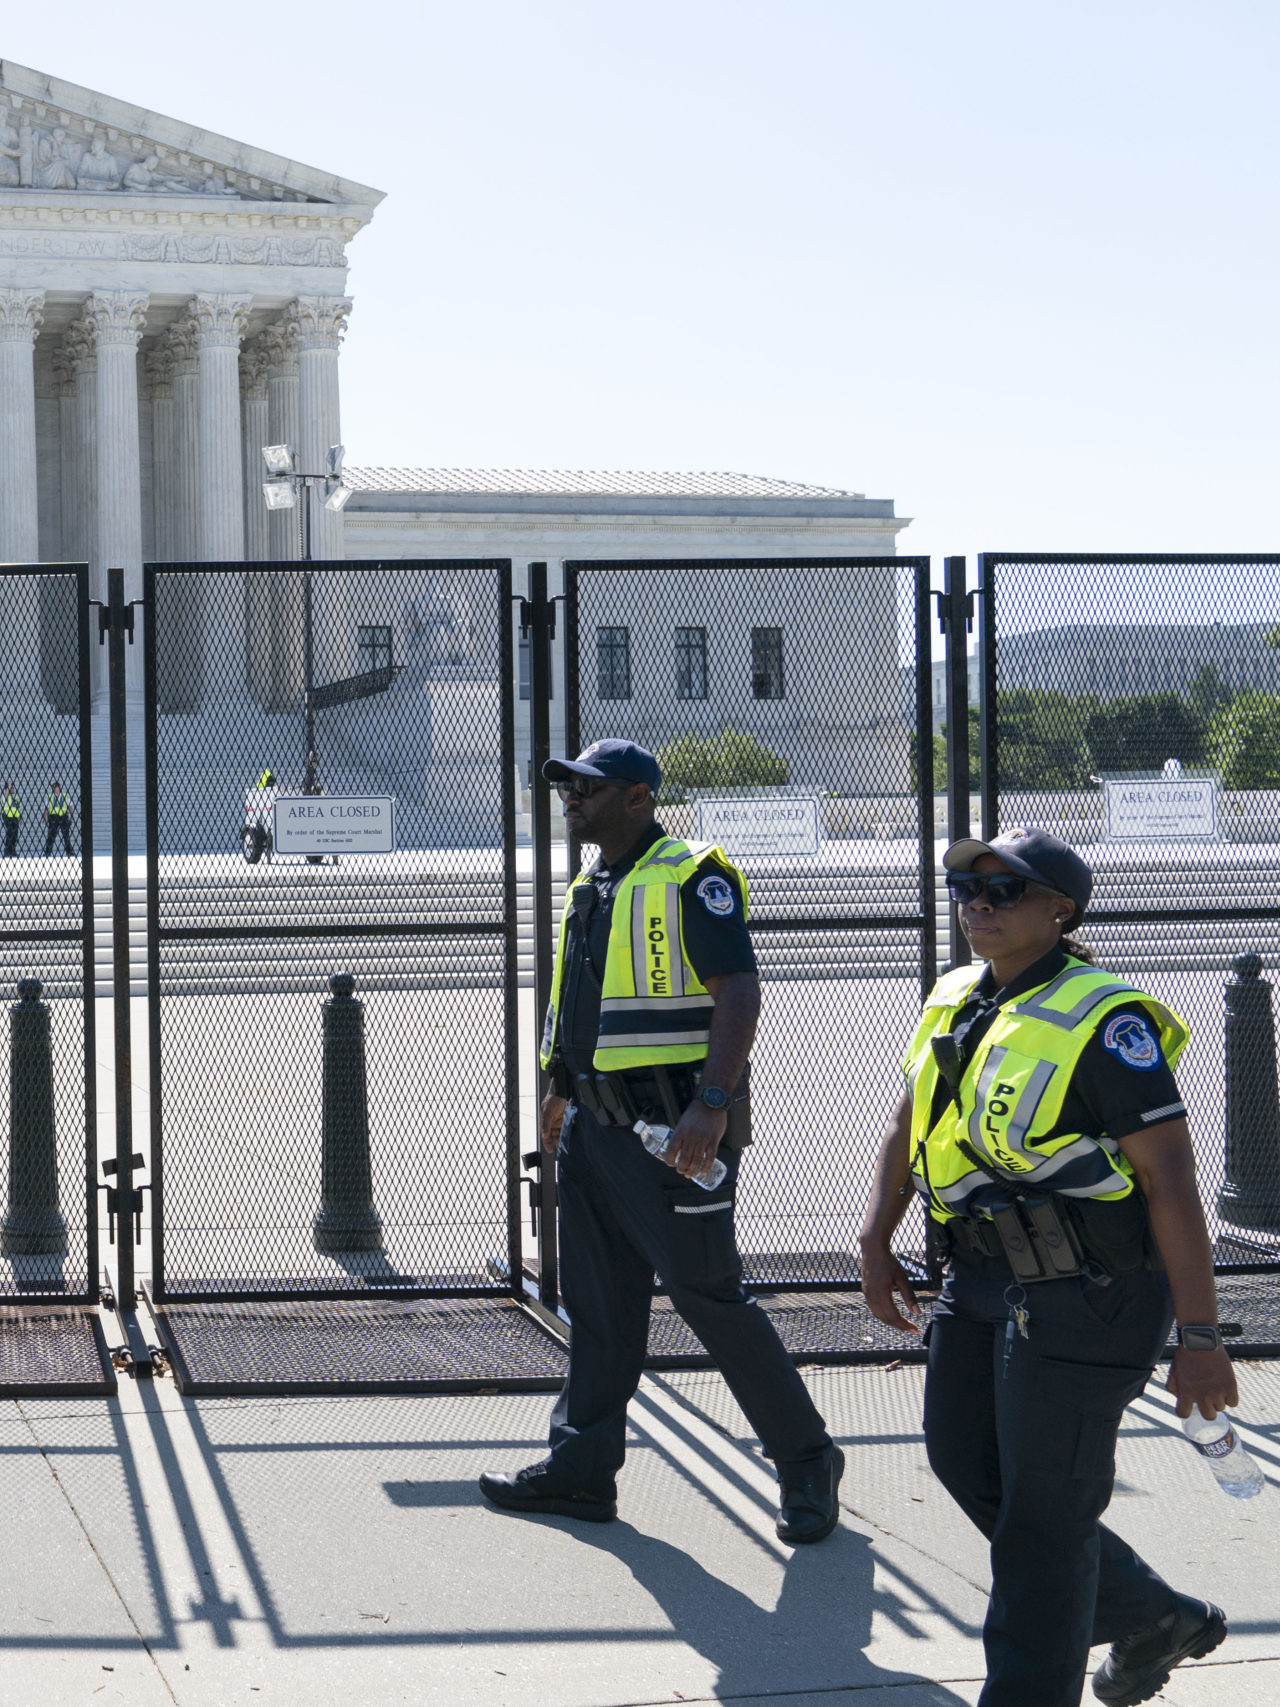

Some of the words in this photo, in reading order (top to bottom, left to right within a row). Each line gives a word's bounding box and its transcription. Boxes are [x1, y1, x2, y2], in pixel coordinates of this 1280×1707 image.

[65, 239, 106, 255] LAW
[1120, 792, 1154, 803] AREA
[1158, 791, 1203, 802] CLOSED
[288, 806, 325, 818] AREA
[330, 806, 381, 818] CLOSED
[714, 810, 748, 821] AREA
[754, 809, 804, 820] CLOSED
[326, 829, 347, 837] Supreme
[648, 917, 667, 994] POLICE
[986, 1083, 1027, 1172] POLICE
